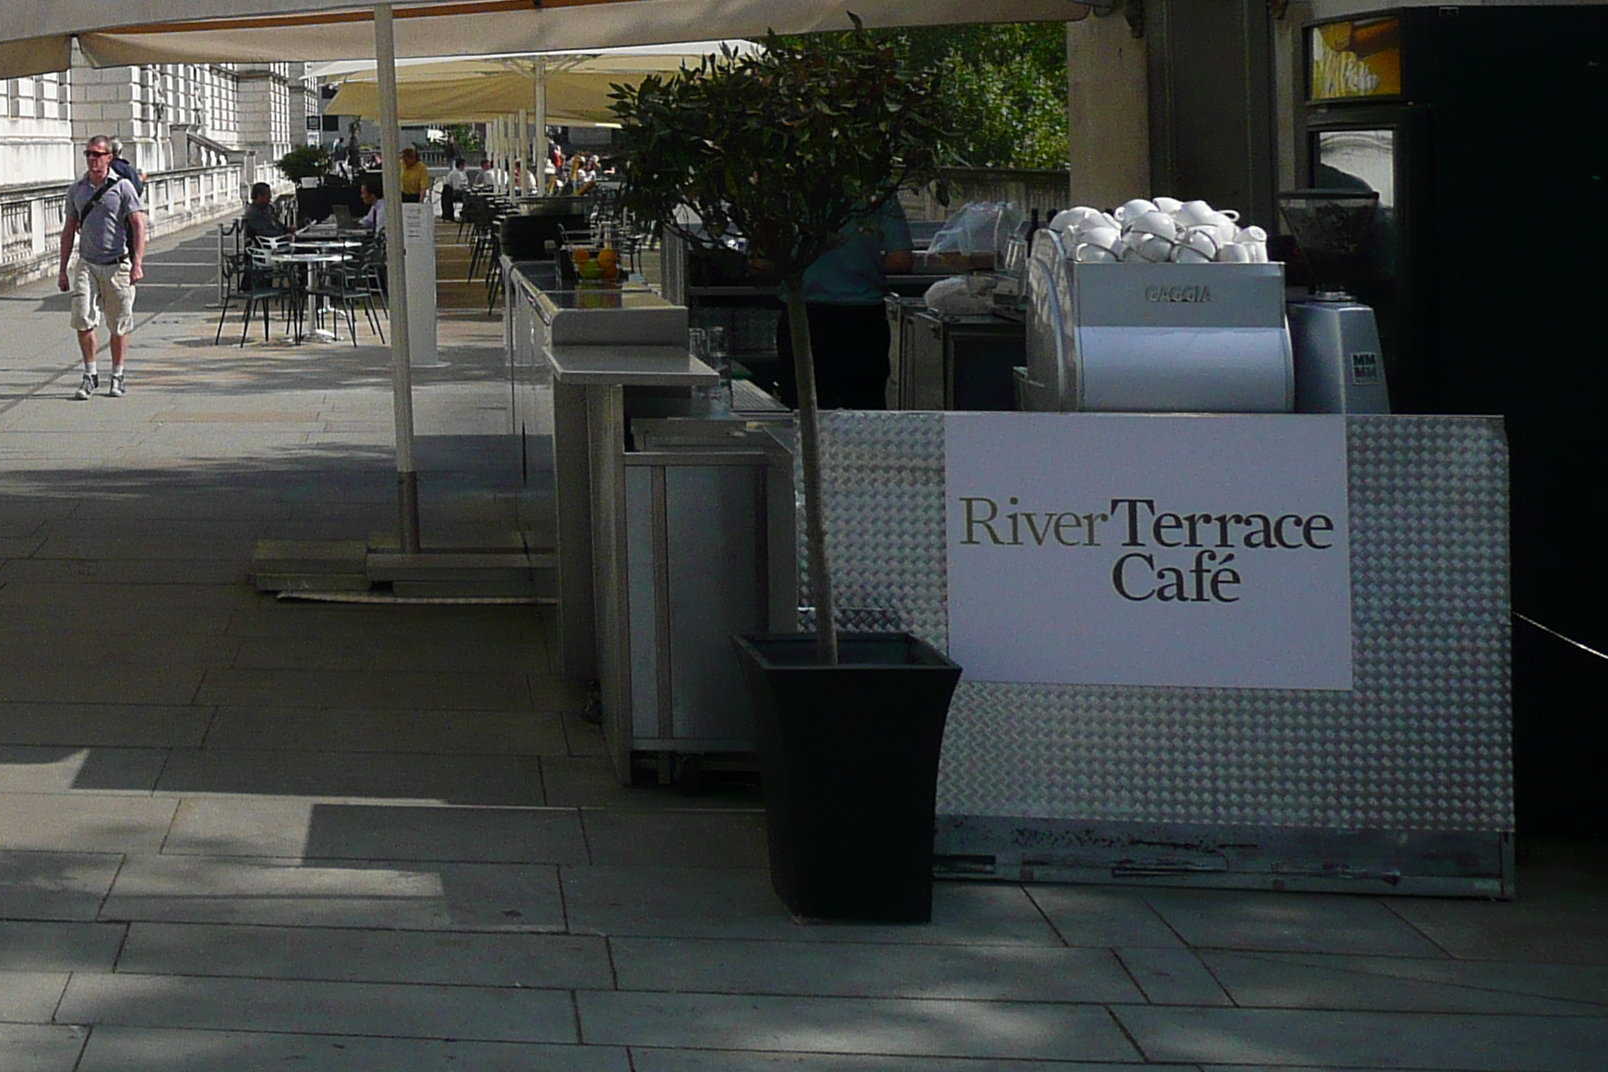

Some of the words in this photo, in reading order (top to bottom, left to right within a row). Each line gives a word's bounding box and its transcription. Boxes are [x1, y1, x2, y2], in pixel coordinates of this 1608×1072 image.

[1145, 284, 1212, 303] GAGGIA
[958, 496, 1109, 547] River
[1110, 498, 1334, 550] Terrace
[1111, 550, 1242, 603] Café
